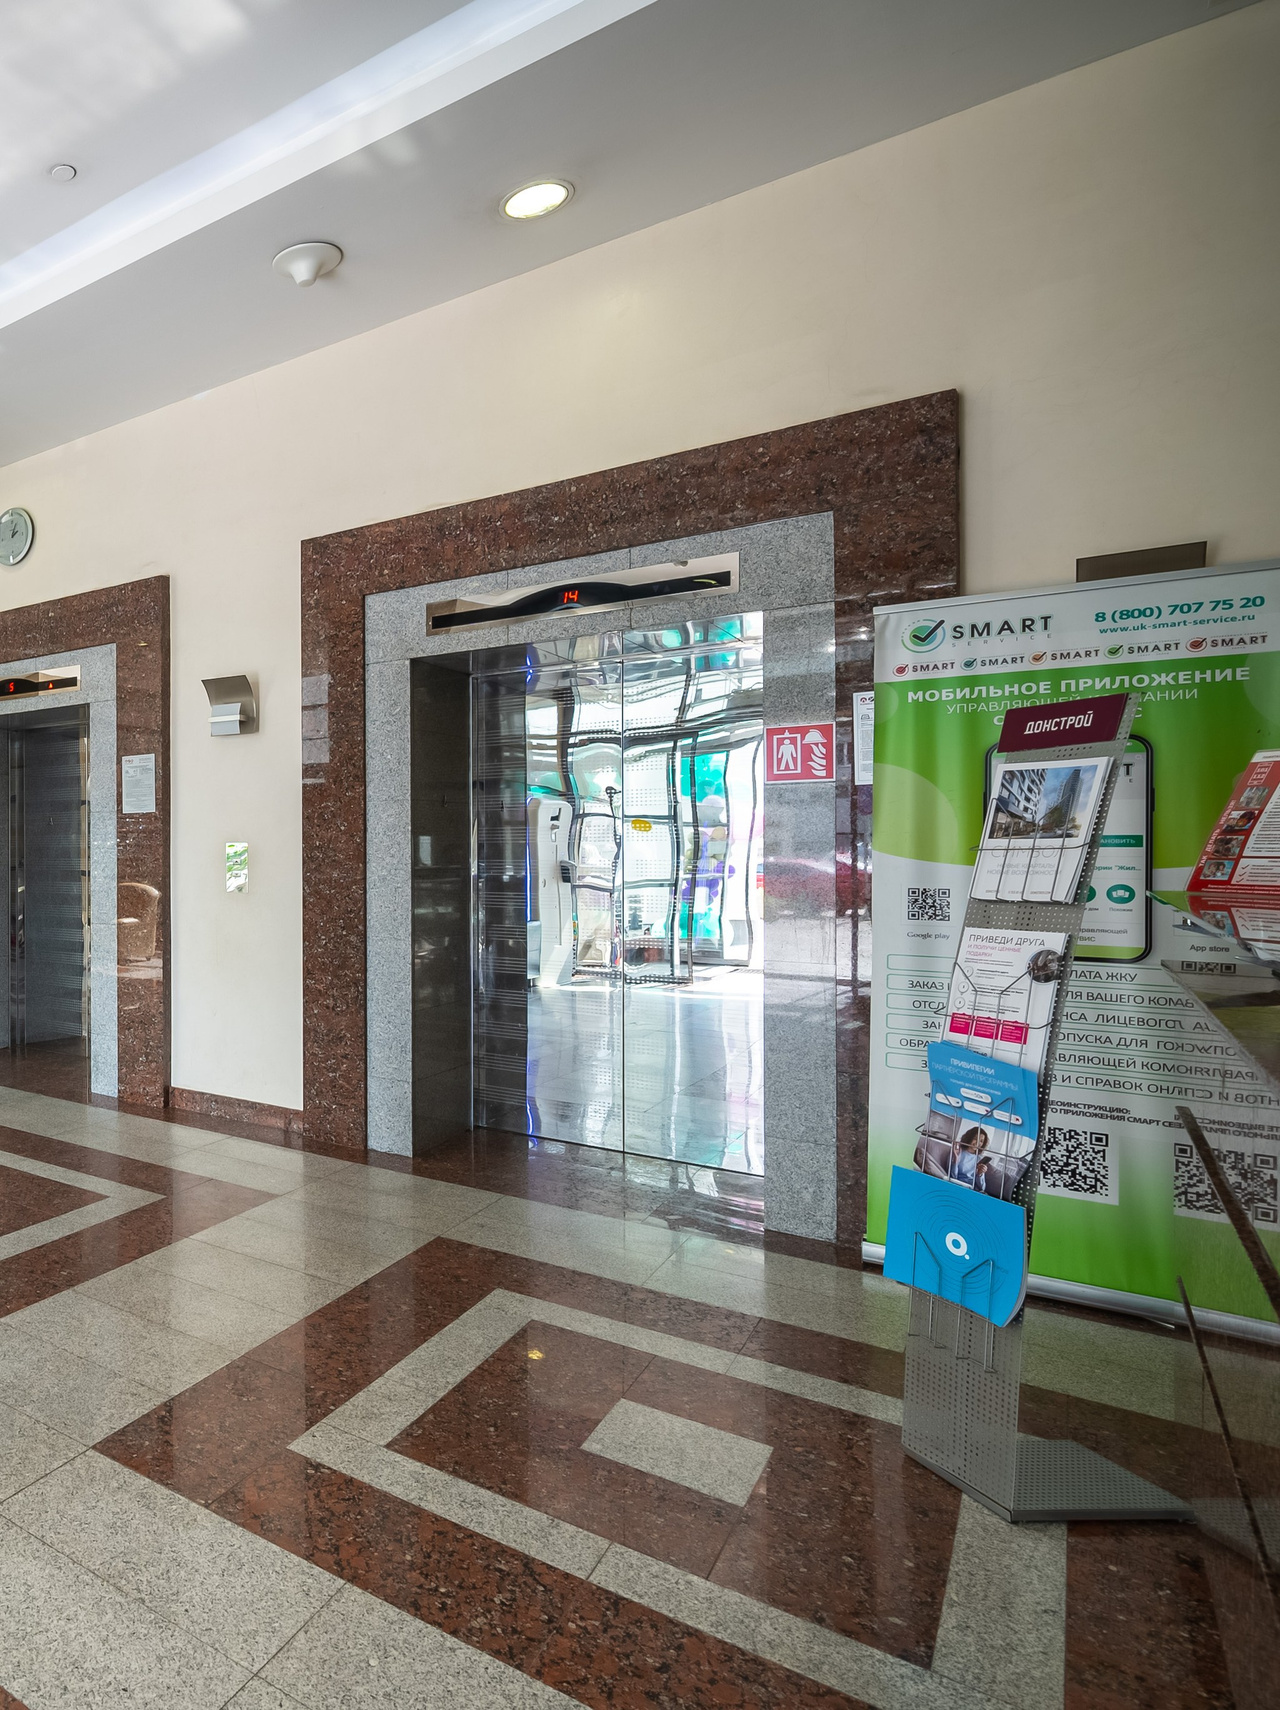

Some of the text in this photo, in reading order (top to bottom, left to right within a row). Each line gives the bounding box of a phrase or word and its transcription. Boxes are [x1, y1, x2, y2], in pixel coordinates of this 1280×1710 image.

[563, 590, 579, 604] 14
[1094, 595, 1266, 624] 8 (800) 707 75 20
[951, 615, 1052, 640] SMART
[1098, 613, 1256, 634] www.uk-smart-service.ru
[951, 633, 1053, 648] SERVICE
[1210, 634, 1269, 648] SMART
[1050, 648, 1101, 661] SMART
[1127, 642, 1181, 655] SMART
[912, 661, 956, 673] SMART
[980, 655, 1025, 667] SMART
[907, 667, 1251, 703] МОБИЛЬНОЕ ПРИЛОЖЕНИЕ
[1023, 710, 1094, 735] ДОНСТРОЙ
[991, 844, 1067, 858] СИМВОЛ
[906, 931, 950, 940] Google play
[969, 934, 1046, 947] ПРИВЕДИ ДРУГА
[1189, 944, 1230, 953] App store
[1105, 972, 1138, 982] ЖКУ
[907, 980, 945, 991] ЗАКАЗ
[1086, 991, 1145, 1005] ВАШЕГО
[1116, 1035, 1148, 1049] ДЛЯ
[950, 1058, 995, 1076] ПРИВИЛЕГИИ
[1061, 1075, 1072, 1084] И
[1075, 1075, 1144, 1092] СПРАВОК
[1059, 1107, 1126, 1122] ПРИЛОЖЕНИЯ
[1127, 1115, 1161, 1127] СМАРТ
